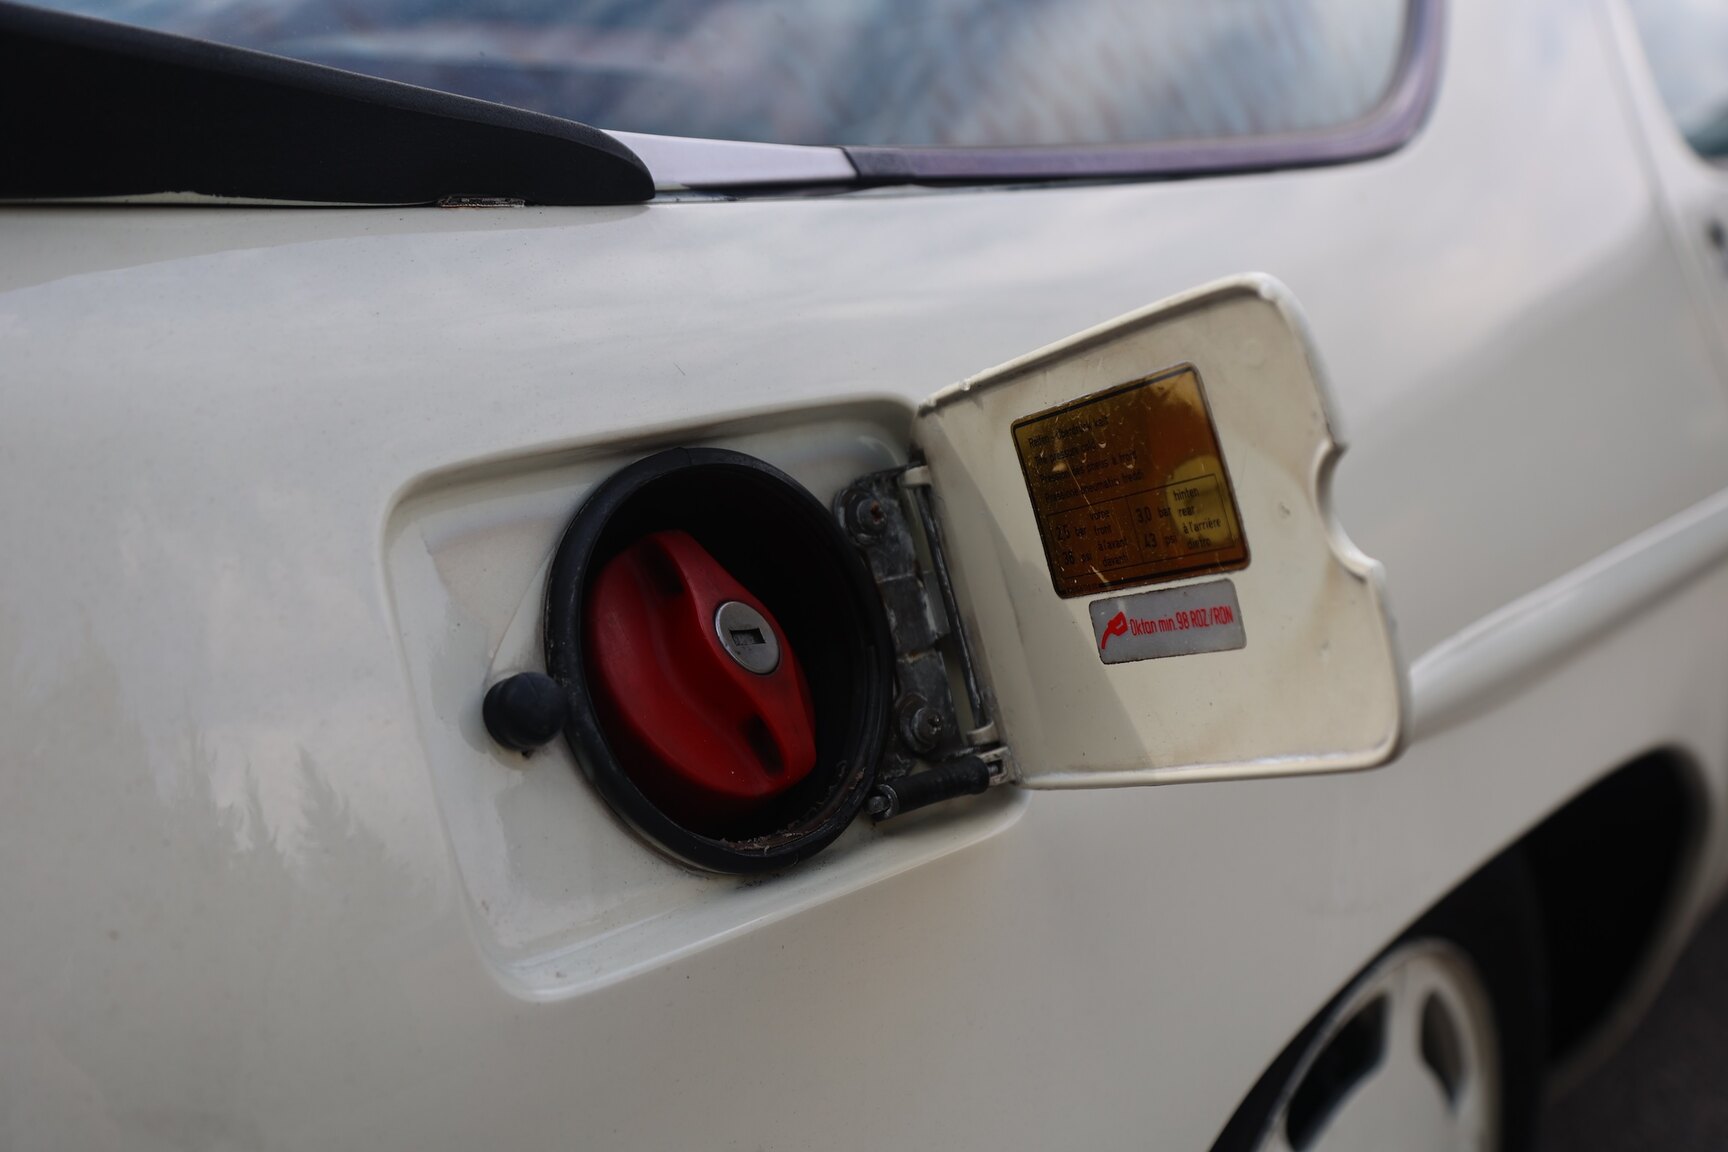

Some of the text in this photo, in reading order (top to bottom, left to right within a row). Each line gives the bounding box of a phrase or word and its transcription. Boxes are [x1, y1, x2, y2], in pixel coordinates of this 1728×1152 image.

[1173, 486, 1199, 500] hinten
[1157, 506, 1171, 518] bar
[1178, 505, 1195, 517] rear
[1094, 524, 1112, 536] front
[1143, 533, 1178, 549] 43 psi
[1129, 617, 1157, 636] Oktan
[1176, 611, 1190, 630] 98
